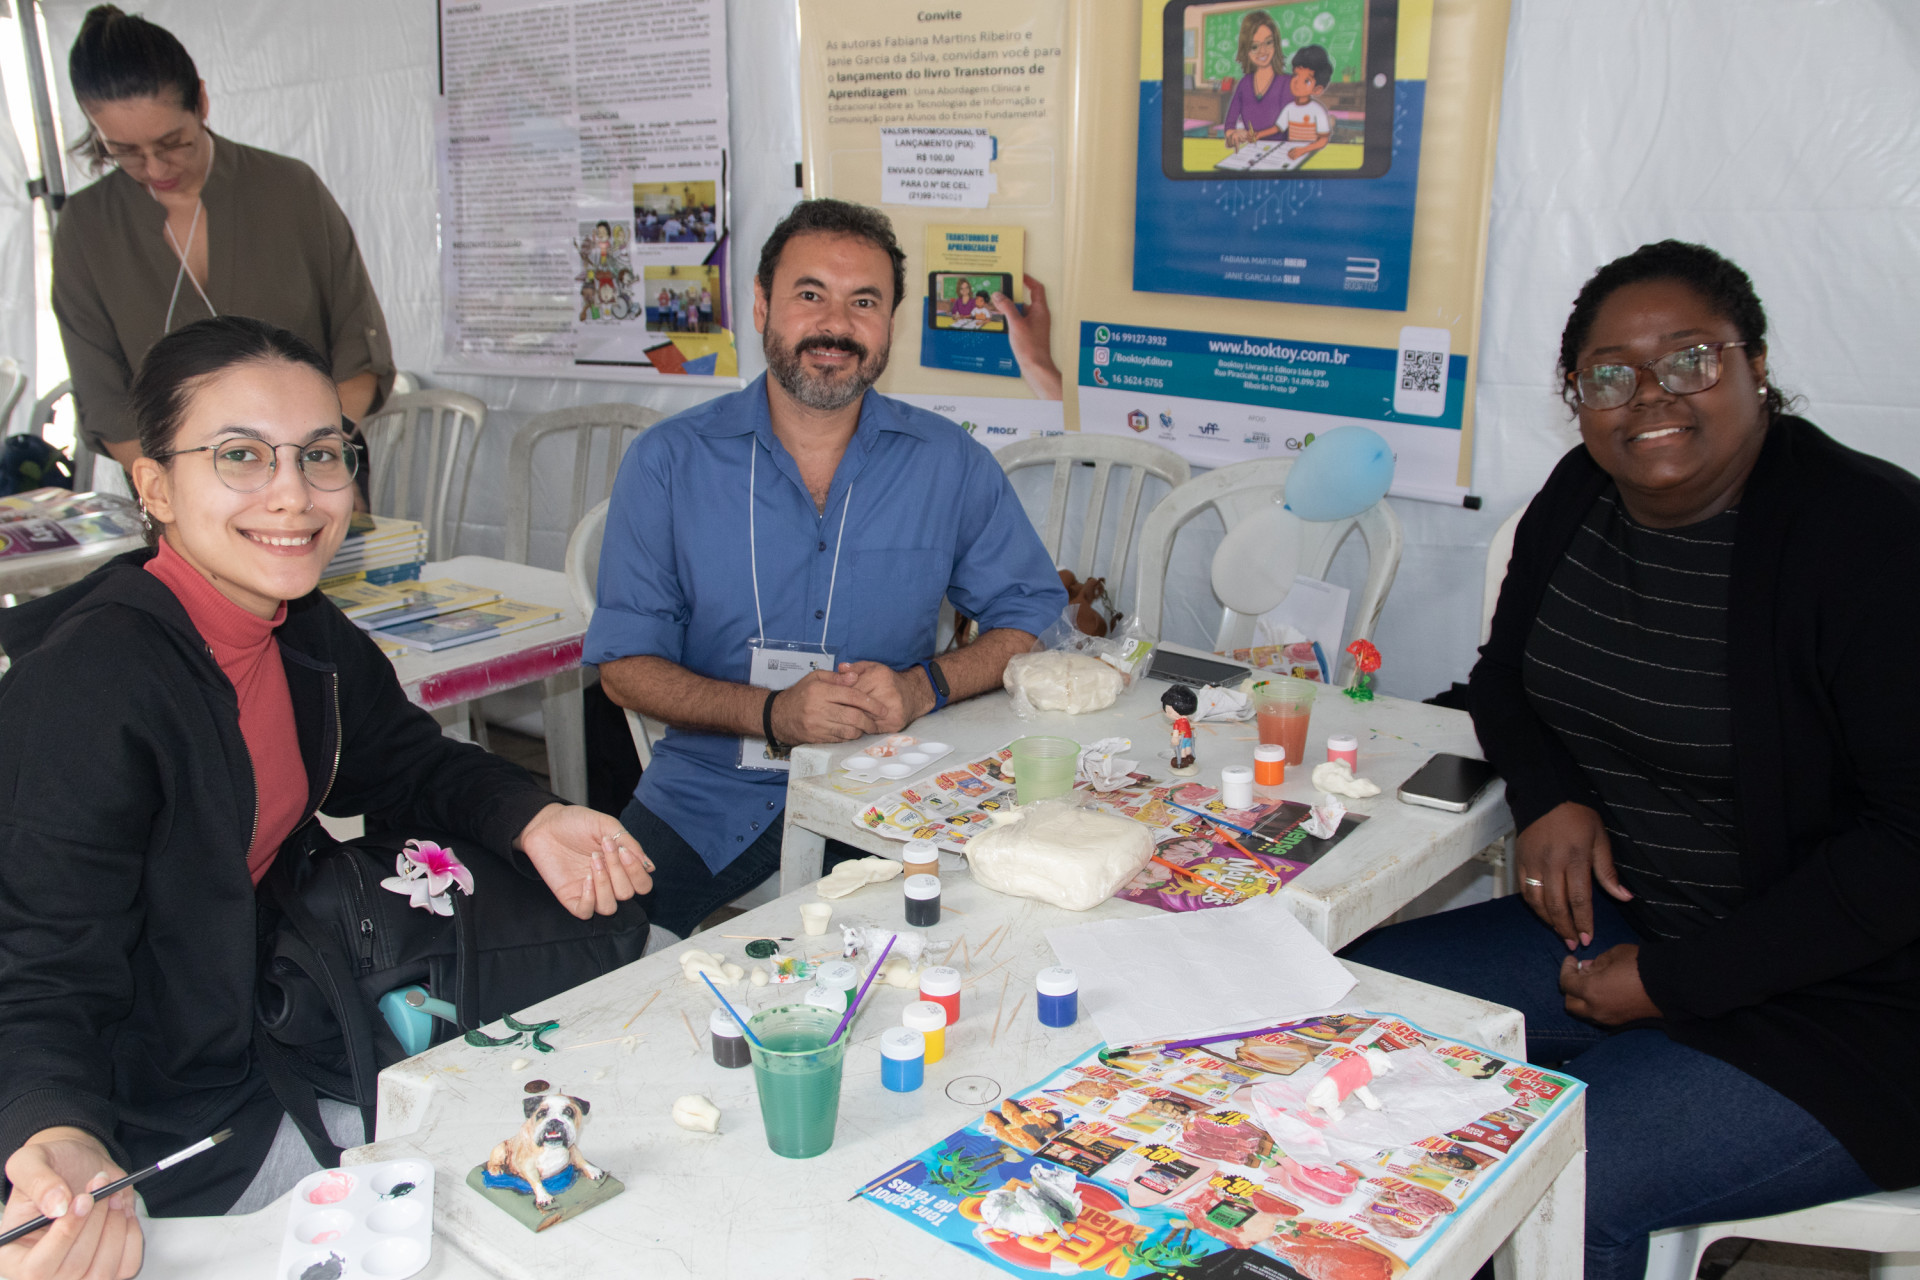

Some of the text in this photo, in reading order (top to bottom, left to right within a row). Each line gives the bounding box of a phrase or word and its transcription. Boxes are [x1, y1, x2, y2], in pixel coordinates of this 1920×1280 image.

[917, 9, 962, 21] Convite
[826, 30, 1032, 49] As autoras Fabiana Martins Ribeiro e
[827, 56, 852, 66] Janie
[855, 54, 890, 64] Garcia
[893, 53, 907, 63] da
[942, 49, 998, 60] convidam
[1002, 46, 1030, 58] você
[1034, 48, 1061, 58] para
[828, 63, 1045, 83] o lançamento do livro Transtornos de
[937, 86, 989, 96] Abordagem
[917, 99, 967, 109] Tecnologias
[969, 98, 981, 106] de
[939, 112, 950, 120] do
[952, 110, 982, 120] Ensino
[912, 128, 974, 136] PROMOCIONAL
[976, 128, 988, 136] DE
[895, 139, 953, 148] LANÇAMENTO
[916, 153, 955, 162] R$ 100,00
[888, 166, 916, 174] ENVIAR
[925, 168, 984, 176] COMPROVANTE
[900, 180, 922, 188] PARA
[923, 180, 929, 188] O
[940, 181, 951, 189] DE
[1220, 254, 1250, 265] FABIANA
[1252, 256, 1283, 266] MARTINS
[1224, 271, 1244, 280] JANIE
[1244, 272, 1271, 282] GARCIA
[1272, 275, 1283, 283] DA
[1111, 332, 1168, 346] 16 99127-3932
[1208, 340, 1350, 365] www.booktoy.com.br
[1112, 352, 1173, 368] /BooktoyEditora
[1218, 359, 1244, 371] Booktoy
[1245, 362, 1268, 372] Livraria
[1274, 365, 1296, 376] Editora
[1112, 374, 1164, 388] 16 3624-5755
[1262, 374, 1274, 383] 442
[1244, 380, 1298, 394] Ribeirão Preto SP
[986, 426, 1018, 435] PROEX
[1198, 422, 1220, 435] uff
[1436, 1046, 1481, 1060] 27,95
[1501, 1067, 1545, 1081] 19,95
[1072, 1121, 1117, 1138] 14,98
[1139, 1178, 1167, 1194] Bordon
[1209, 1176, 1264, 1197] 36,90
[1366, 1177, 1413, 1193] 17,98
[886, 1177, 958, 1214] de Férias
[865, 1184, 948, 1228] Tem sabor
[1396, 1212, 1422, 1226] Seara
[1315, 1222, 1369, 1242] 27,98
